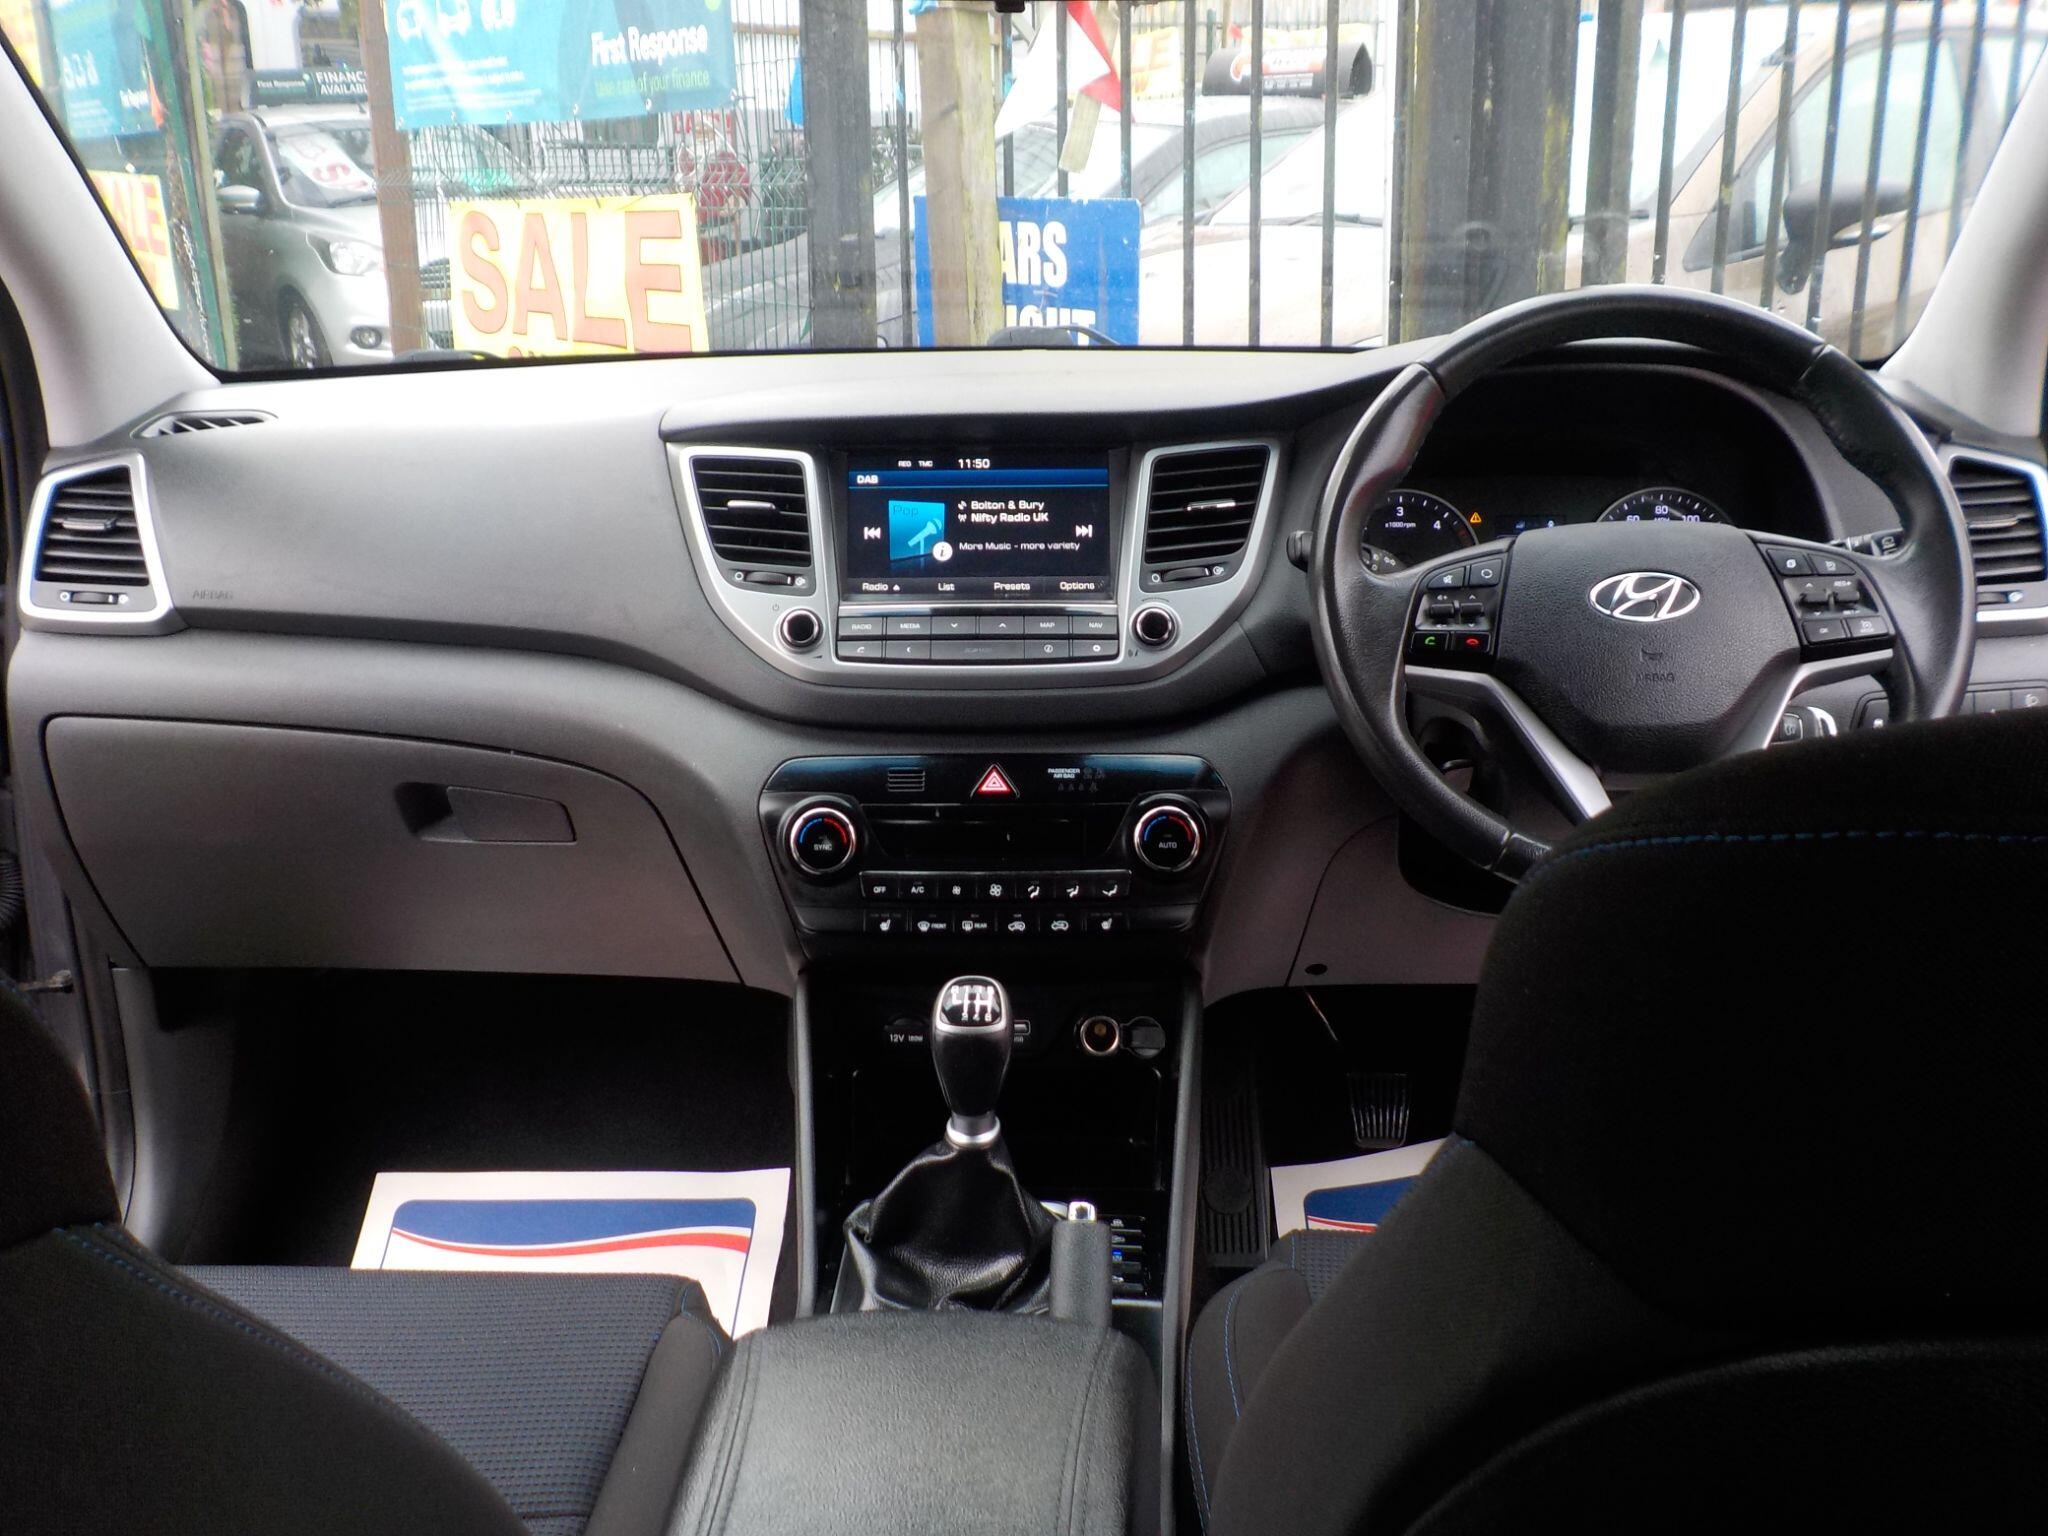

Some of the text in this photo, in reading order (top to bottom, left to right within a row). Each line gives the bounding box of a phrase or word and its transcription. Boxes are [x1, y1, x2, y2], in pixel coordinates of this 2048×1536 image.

[591, 25, 708, 66] First Response
[315, 71, 368, 83] FINANC
[638, 71, 648, 92] of
[649, 74, 670, 94] your
[461, 210, 692, 352] SALE
[958, 459, 991, 469] 11:50
[856, 475, 879, 484] DAB
[971, 500, 1045, 511] Bolton & Bury
[1655, 505, 1669, 515] 80
[1396, 506, 1404, 517] 3
[971, 512, 1049, 523] Nifty Radio UK
[1433, 520, 1442, 531] 4
[959, 541, 984, 550] More
[985, 541, 1012, 550] Music
[1020, 542, 1046, 550] more
[1047, 541, 1081, 552] variety
[862, 582, 889, 591] Radio
[938, 582, 955, 591] List
[994, 582, 1031, 591] Presets
[1060, 581, 1095, 591] Options
[900, 622, 921, 630] MEDIA
[813, 843, 833, 851] SYNC
[1158, 841, 1178, 849] AUTO
[873, 886, 887, 894] OFF
[911, 886, 925, 894] A/C
[889, 1034, 905, 1043] 12V
